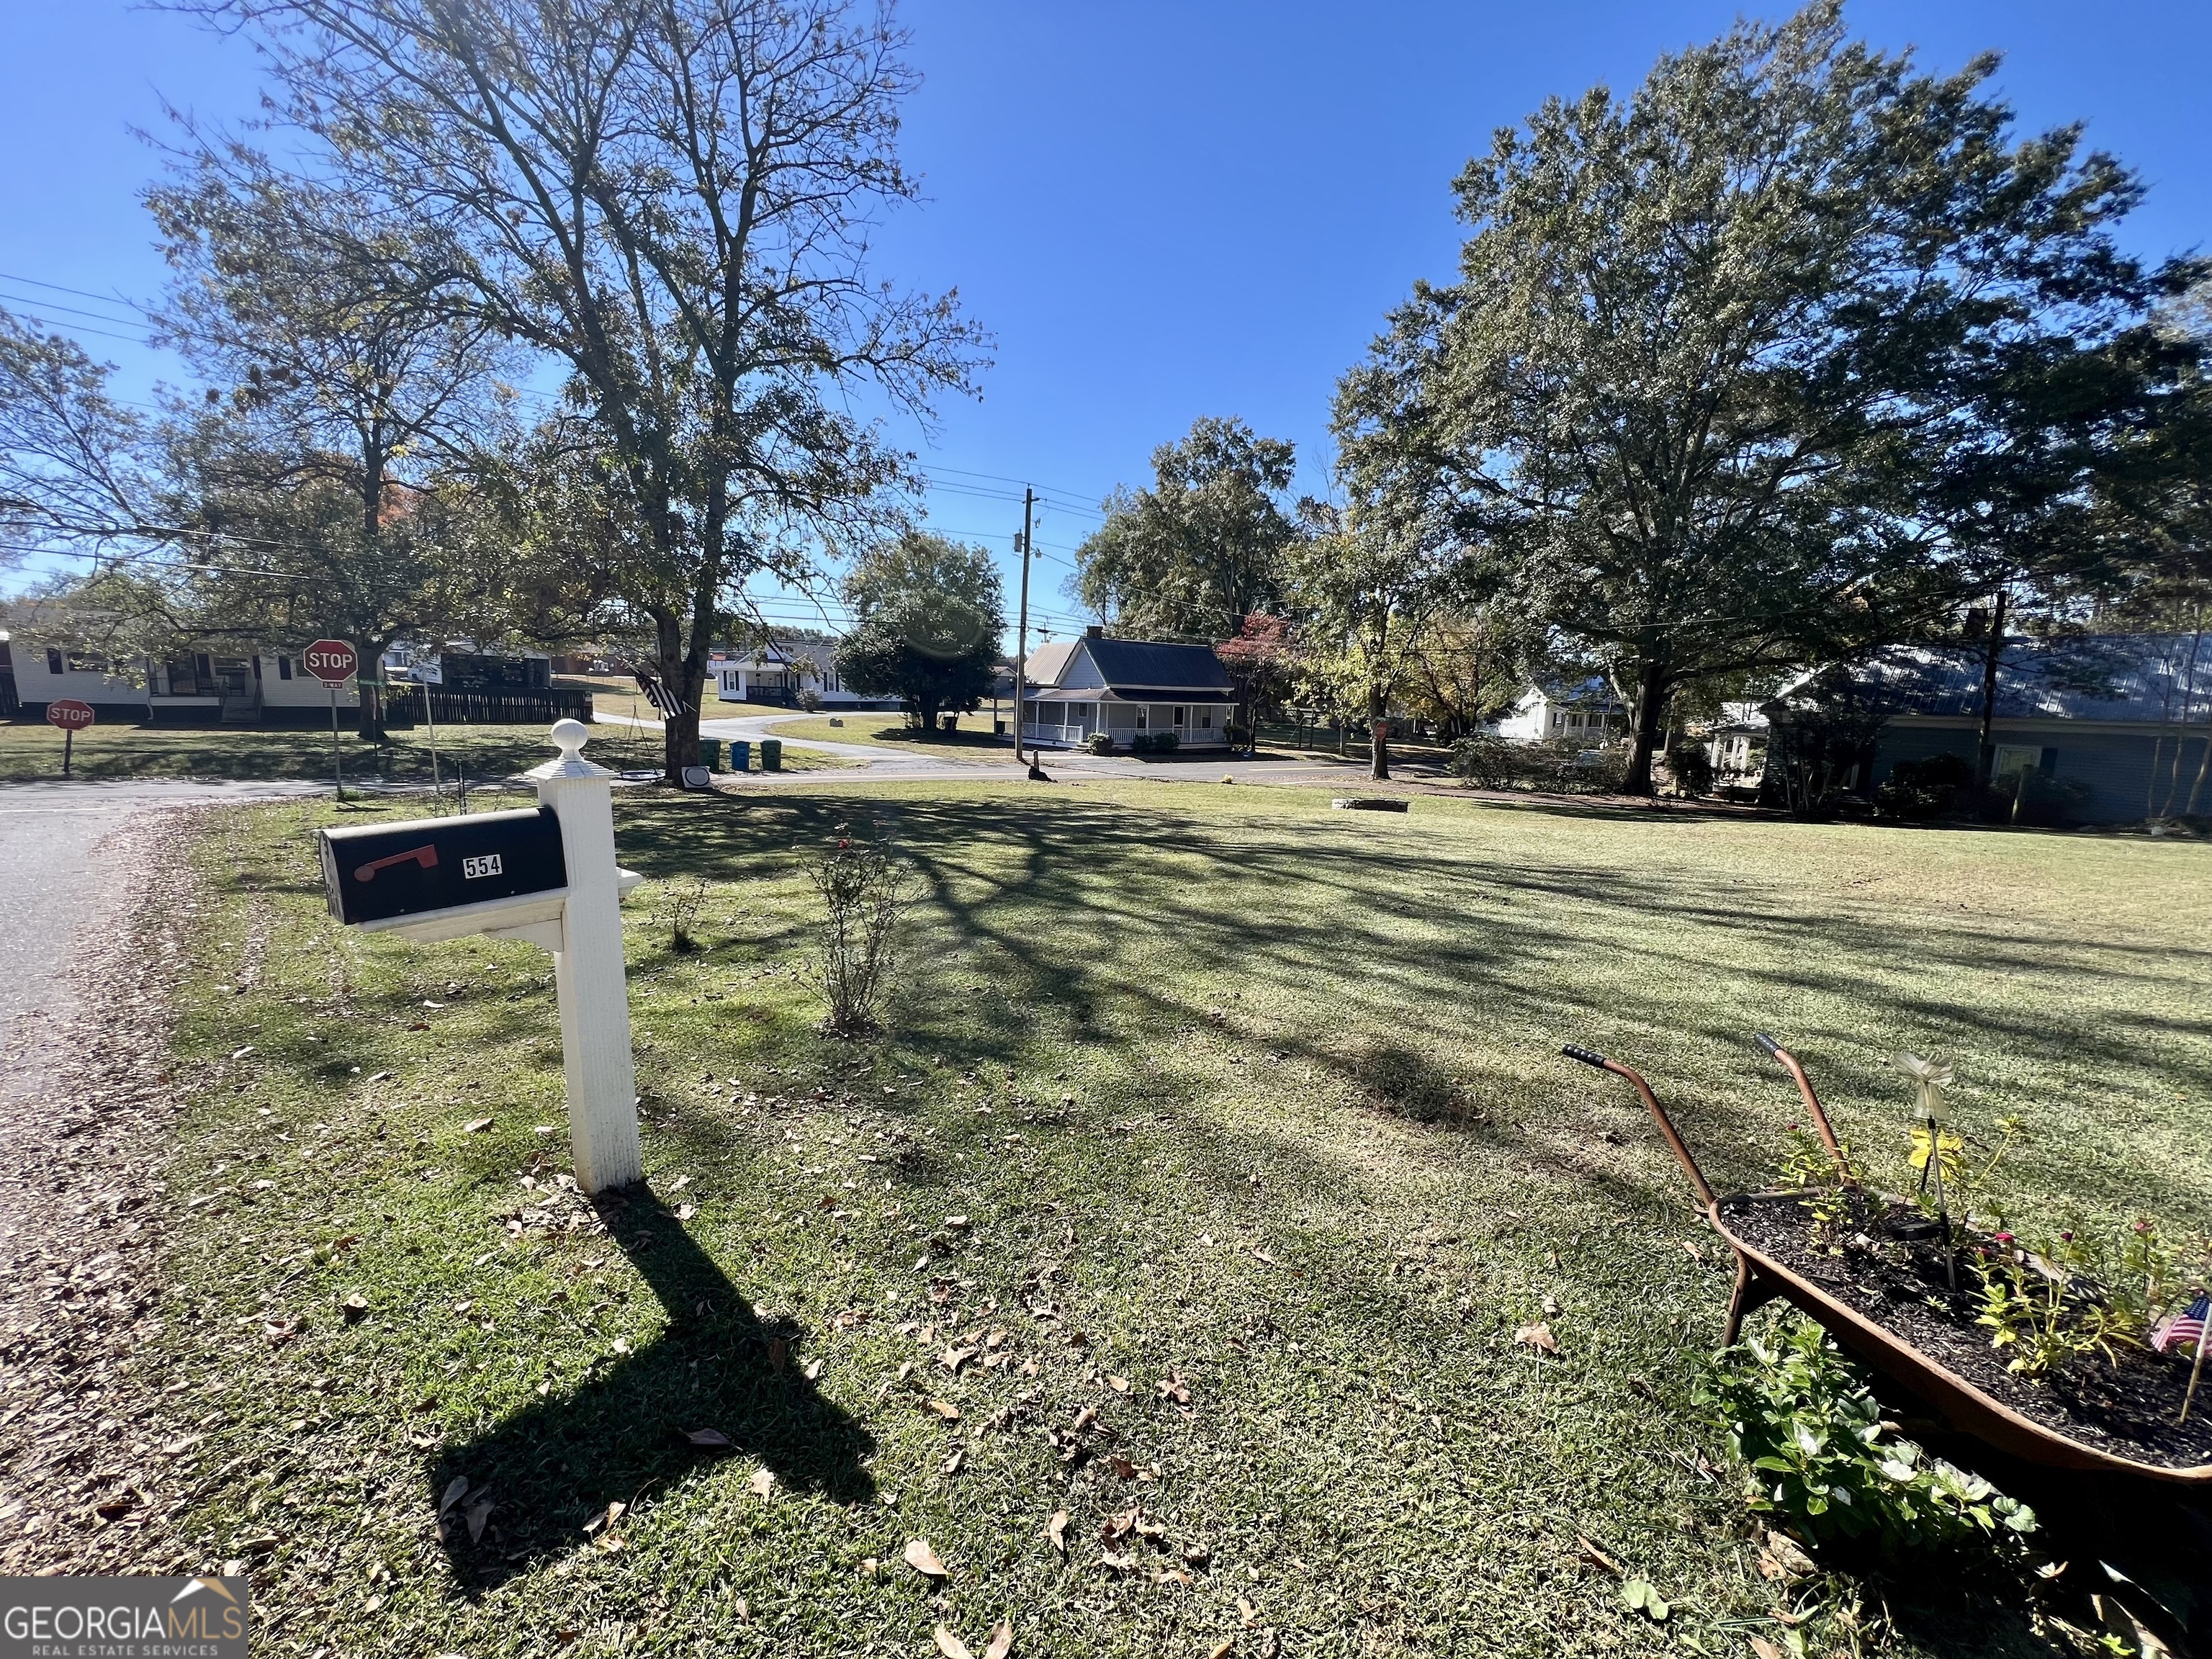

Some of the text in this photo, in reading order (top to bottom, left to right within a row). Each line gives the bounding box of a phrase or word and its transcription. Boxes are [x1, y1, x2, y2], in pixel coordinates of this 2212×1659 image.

[309, 652, 353, 669] STOP
[50, 708, 91, 722] STOP
[466, 855, 500, 877] 554
